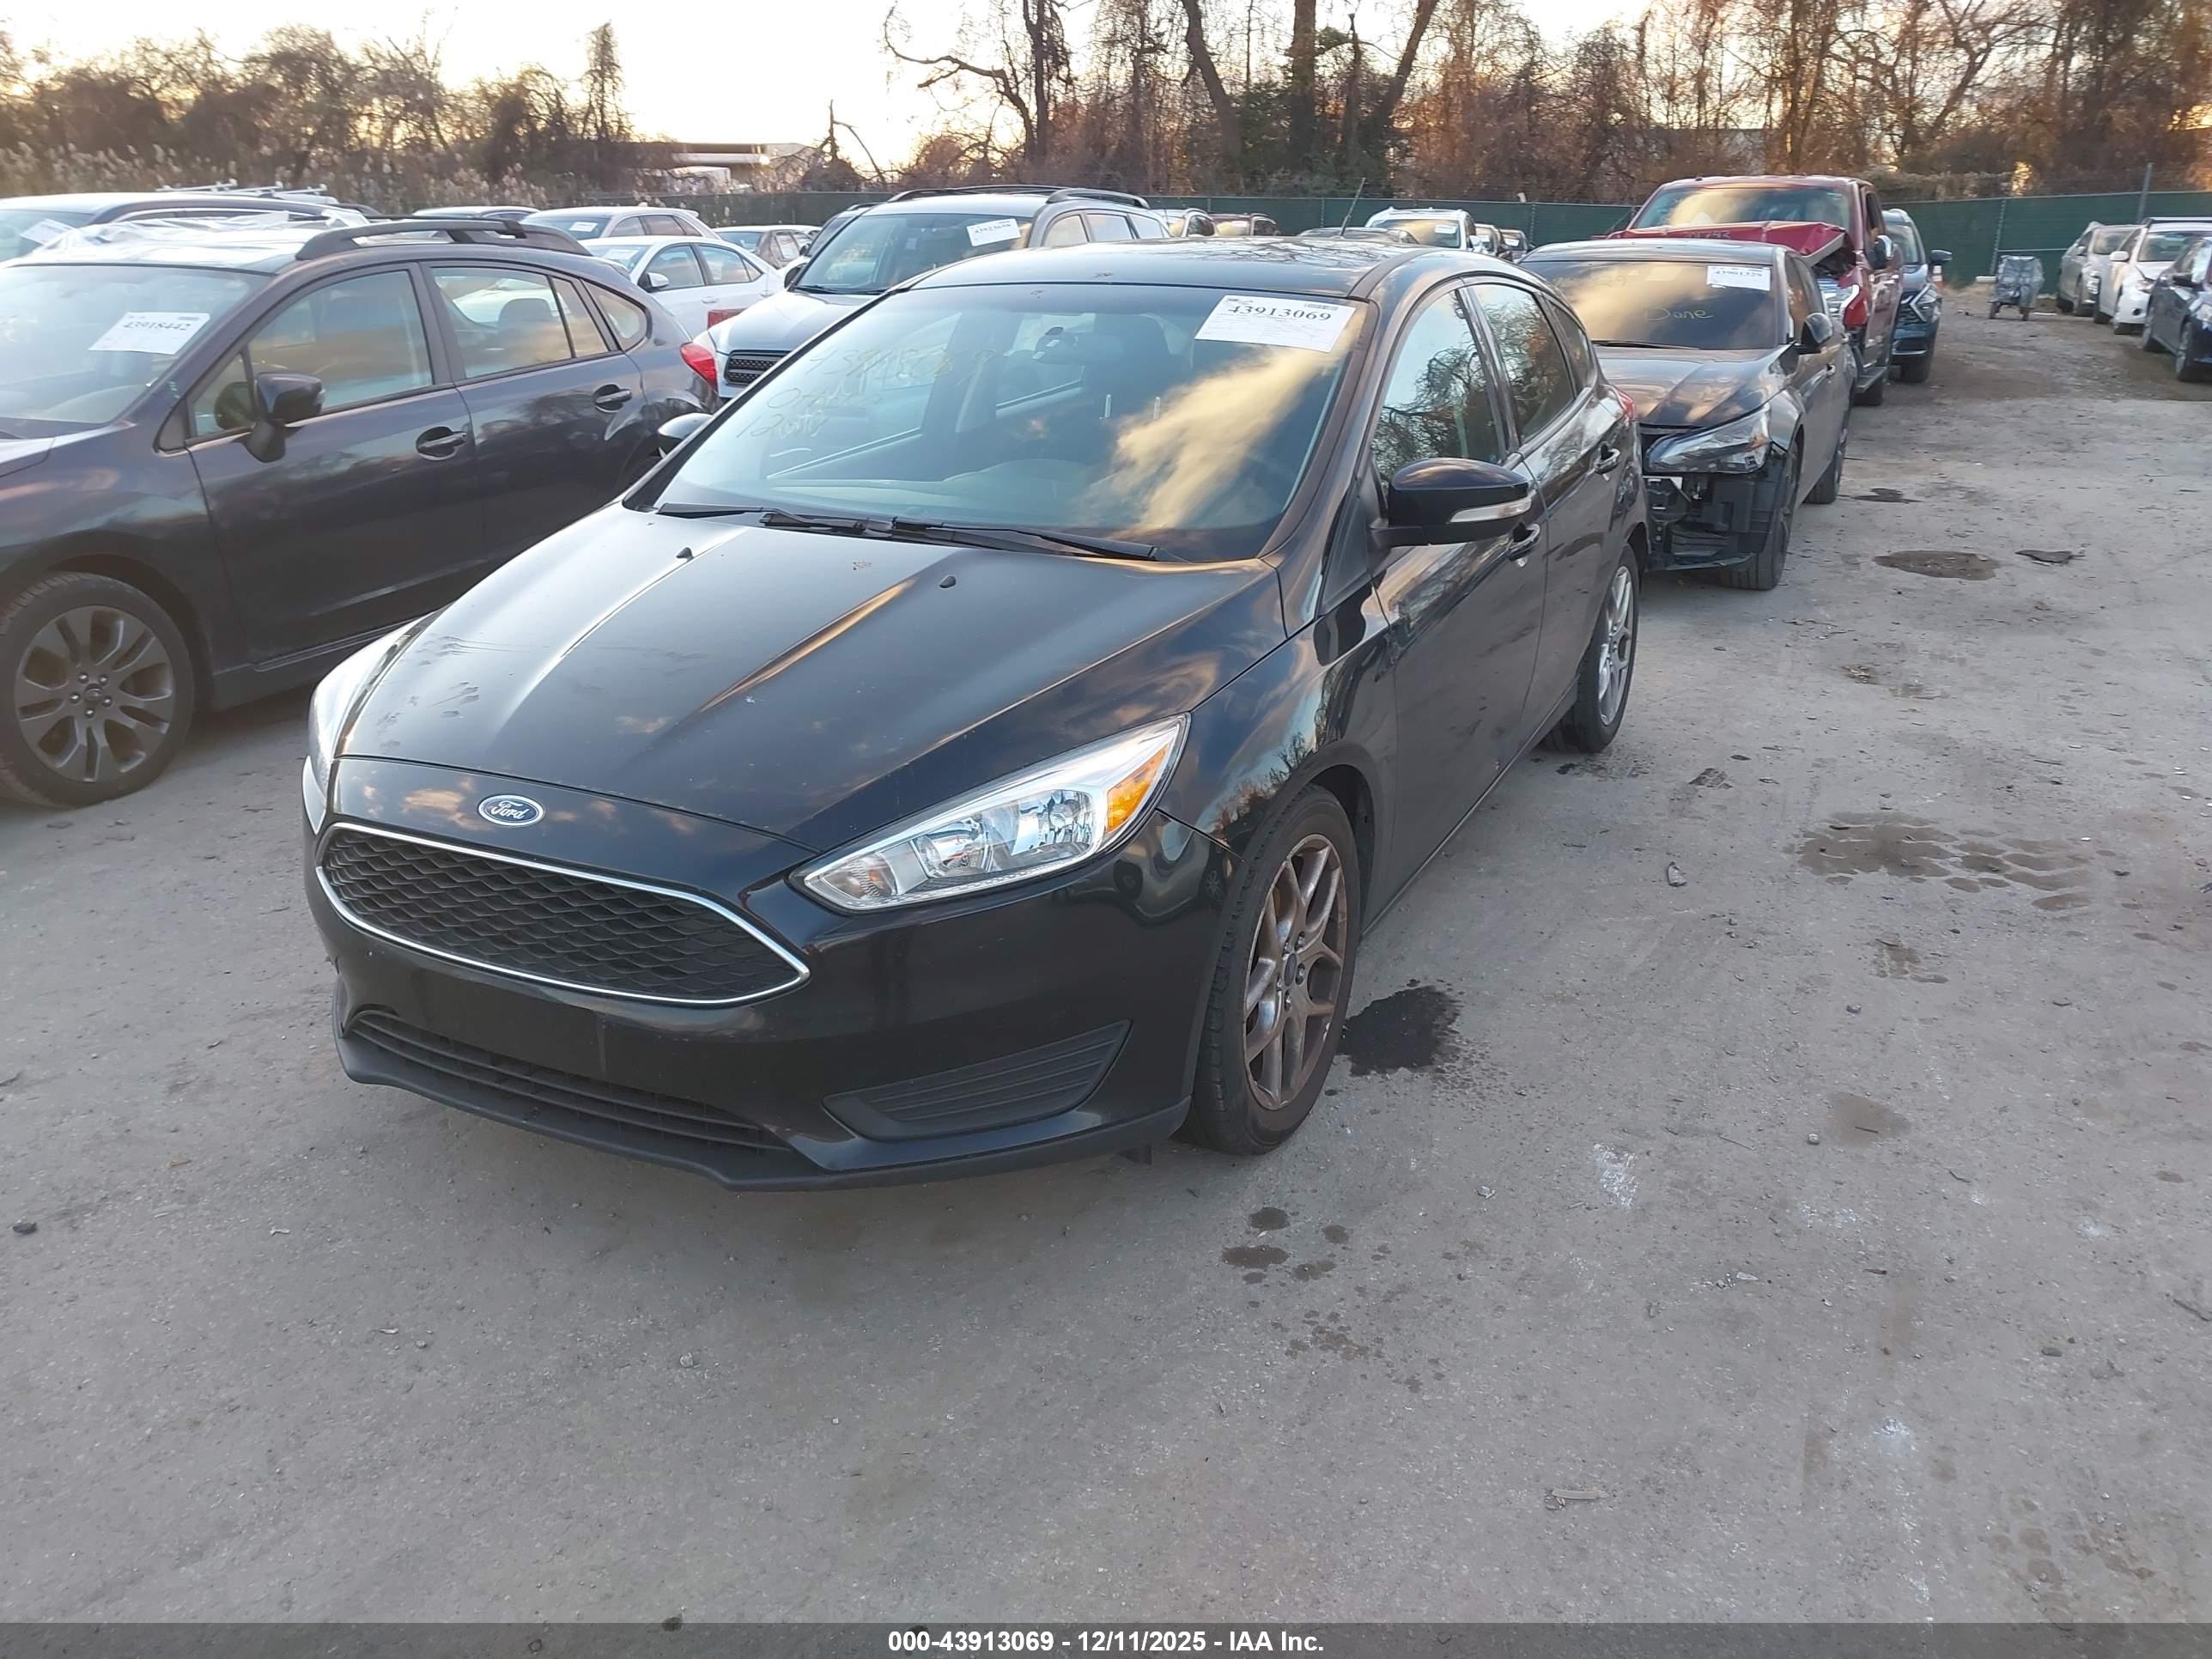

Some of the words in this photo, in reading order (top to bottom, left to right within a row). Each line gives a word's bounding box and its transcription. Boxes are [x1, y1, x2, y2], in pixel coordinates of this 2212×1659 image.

[1227, 305, 1331, 321] 43913069
[1645, 307, 1713, 321] Done
[490, 800, 530, 819] Ford
